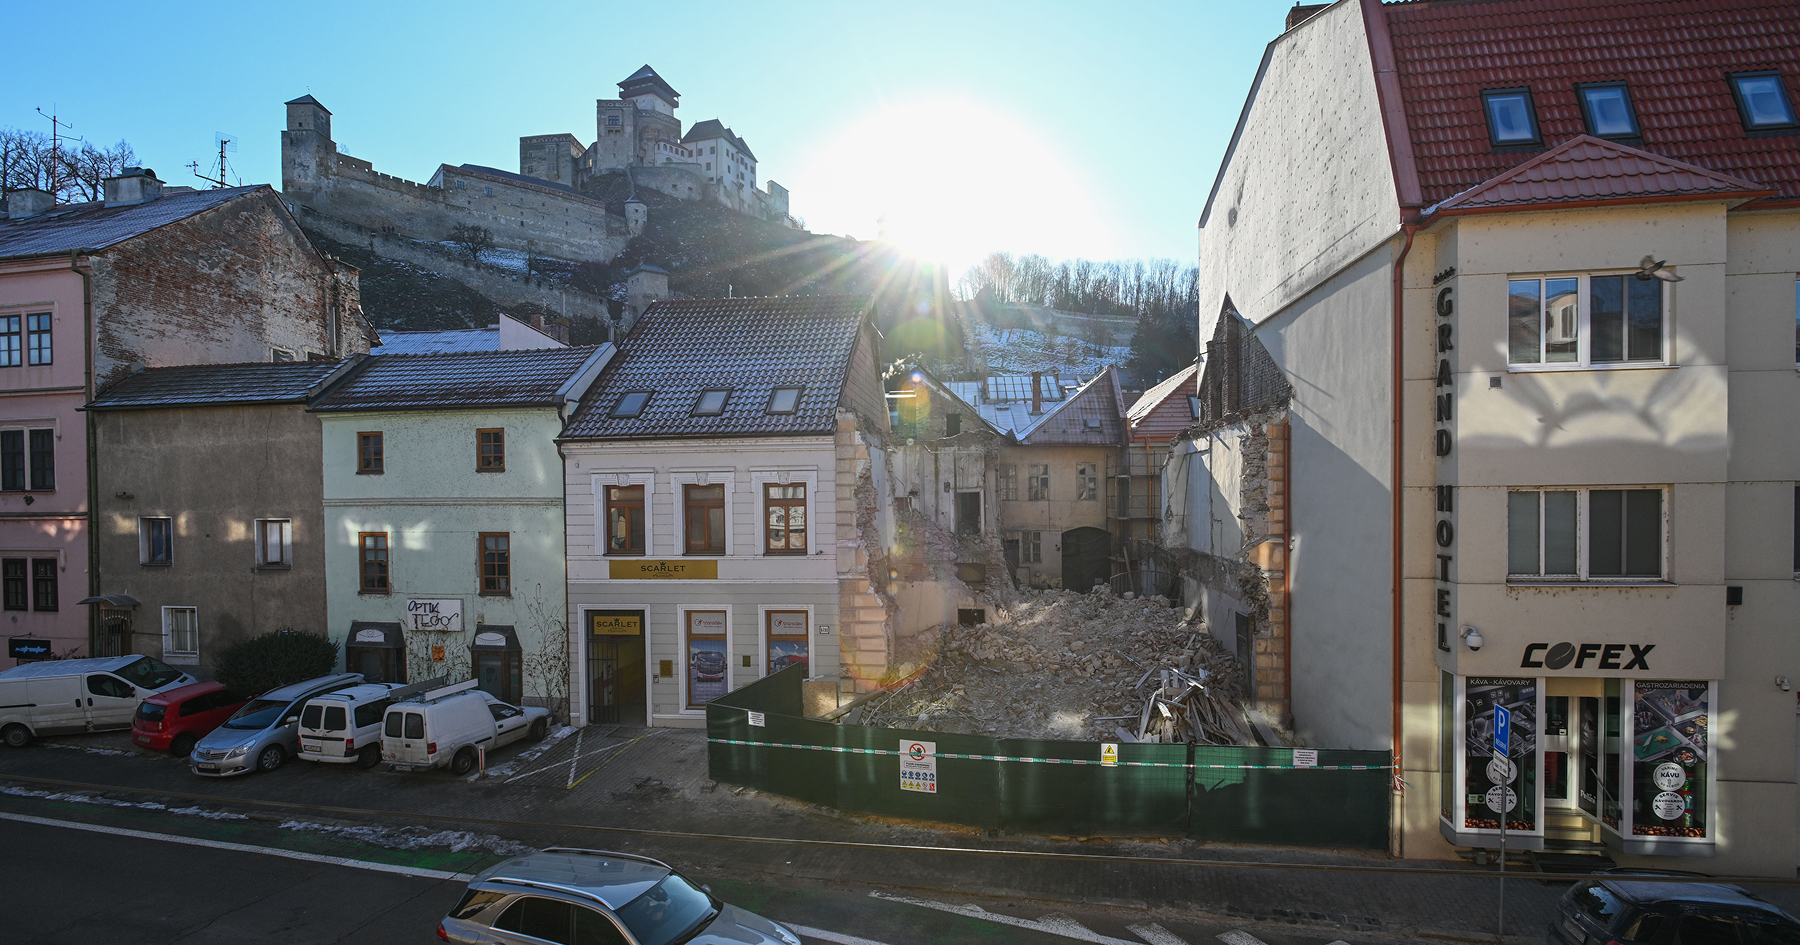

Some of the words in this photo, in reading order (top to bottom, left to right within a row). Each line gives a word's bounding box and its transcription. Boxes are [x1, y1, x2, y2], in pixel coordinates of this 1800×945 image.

[1436, 287, 1453, 457] GRAND
[1436, 485, 1453, 653] HOTEL
[408, 600, 440, 614] OPTIK
[1520, 642, 1656, 670] COFEX
[1493, 678, 1530, 686] KÁVOVARY
[1498, 710, 1505, 735] P
